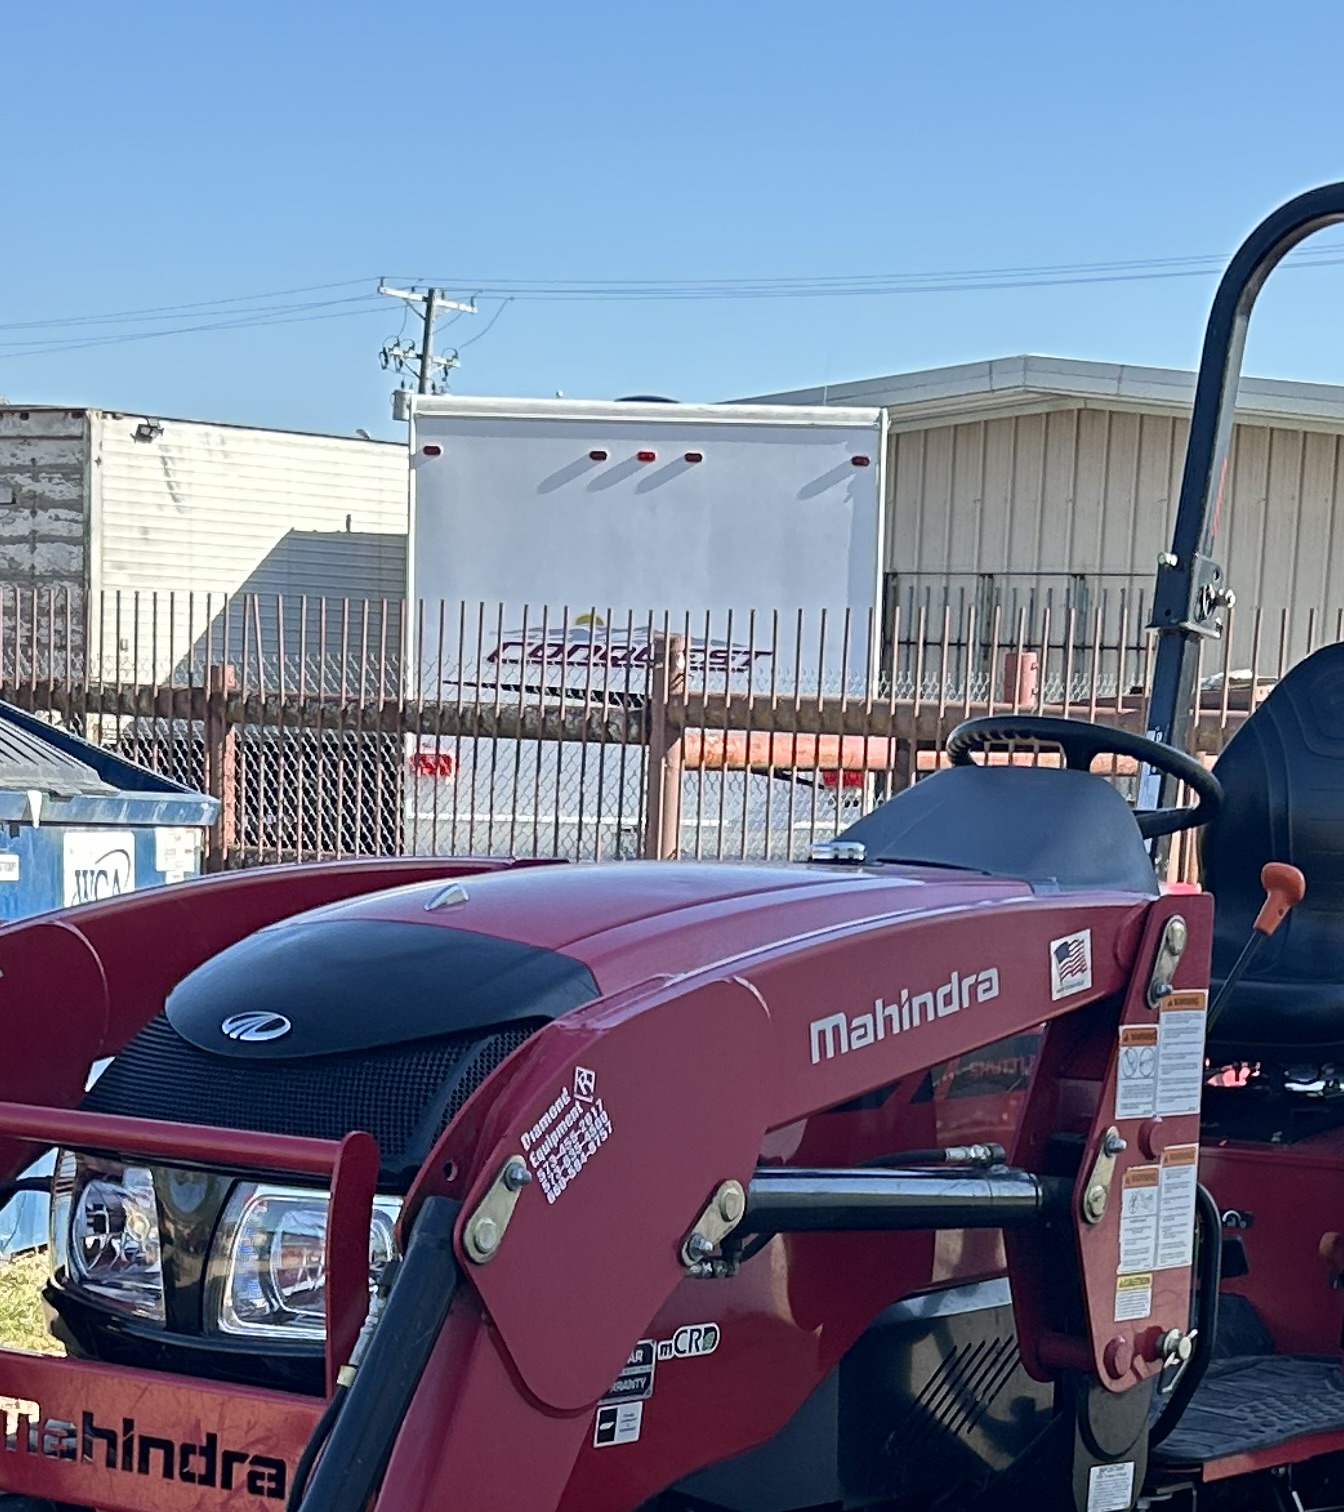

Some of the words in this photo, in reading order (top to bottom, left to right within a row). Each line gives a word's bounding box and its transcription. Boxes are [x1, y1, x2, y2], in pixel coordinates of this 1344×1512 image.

[810, 968, 1000, 1064] Mahindra
[520, 1087, 571, 1151] Diamond
[529, 1101, 584, 1168] Equipment
